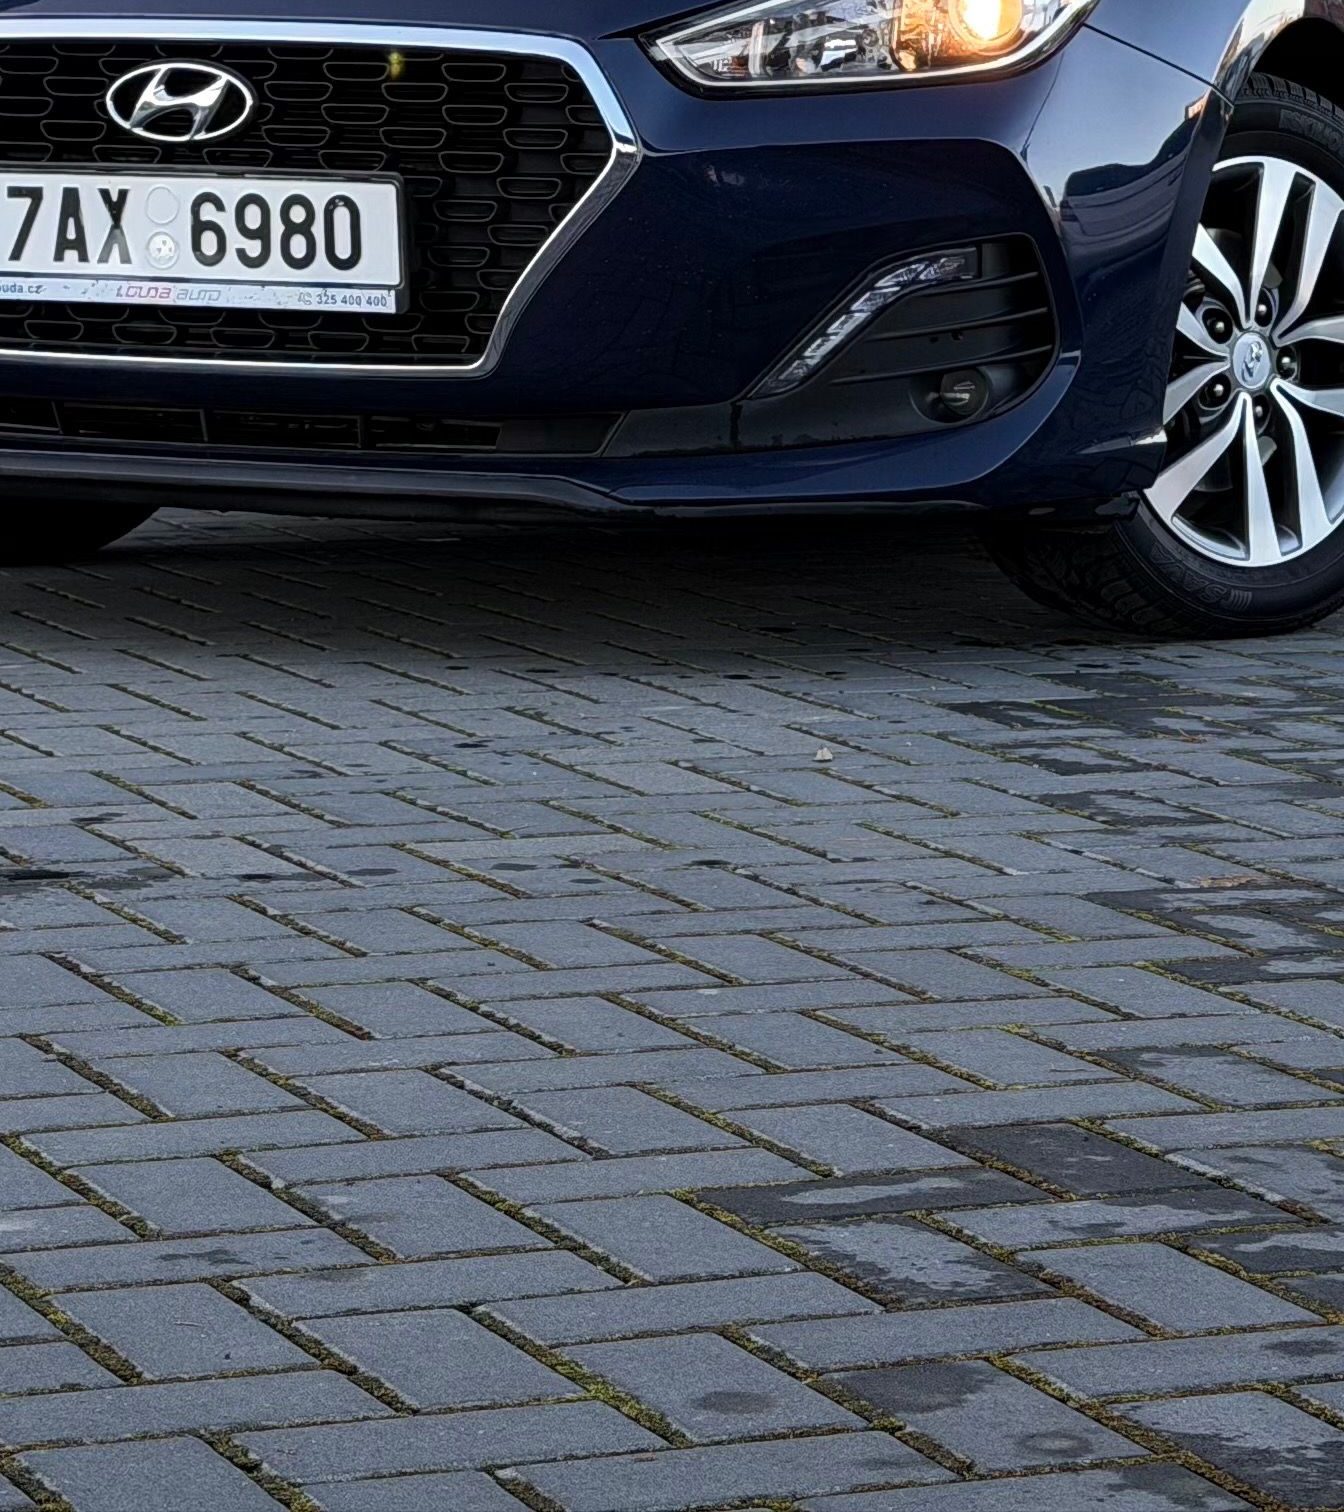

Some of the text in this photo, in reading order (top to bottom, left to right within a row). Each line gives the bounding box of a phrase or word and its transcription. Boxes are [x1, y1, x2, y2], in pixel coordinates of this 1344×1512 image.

[6, 185, 362, 271] 7AX 6980
[316, 293, 338, 306] 325
